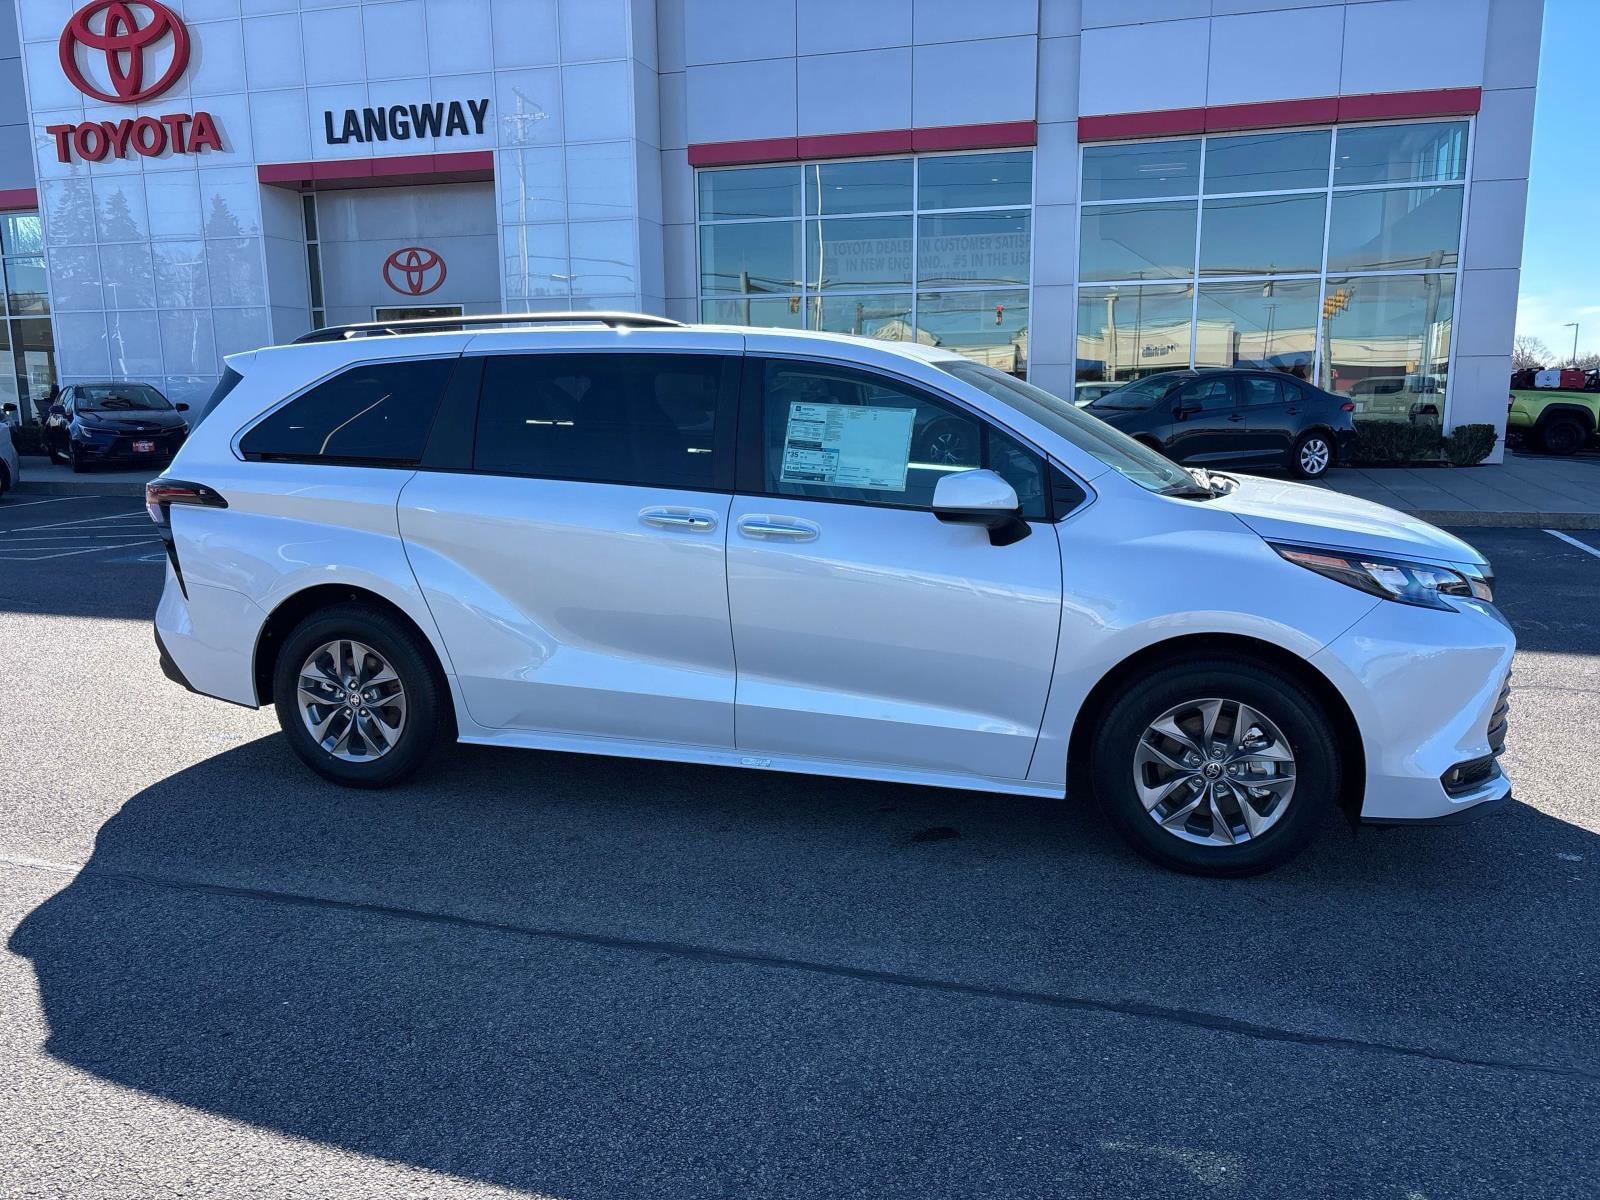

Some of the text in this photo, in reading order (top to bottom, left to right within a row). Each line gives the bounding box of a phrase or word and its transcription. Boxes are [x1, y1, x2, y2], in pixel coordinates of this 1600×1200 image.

[45, 111, 223, 164] TOYOTA
[324, 98, 489, 145] LANGWAY
[832, 241, 873, 256] TOYOTA
[934, 237, 993, 252] CUSTOMER
[861, 257, 884, 271] NEW
[972, 254, 983, 267] IN
[987, 252, 1007, 266] THE
